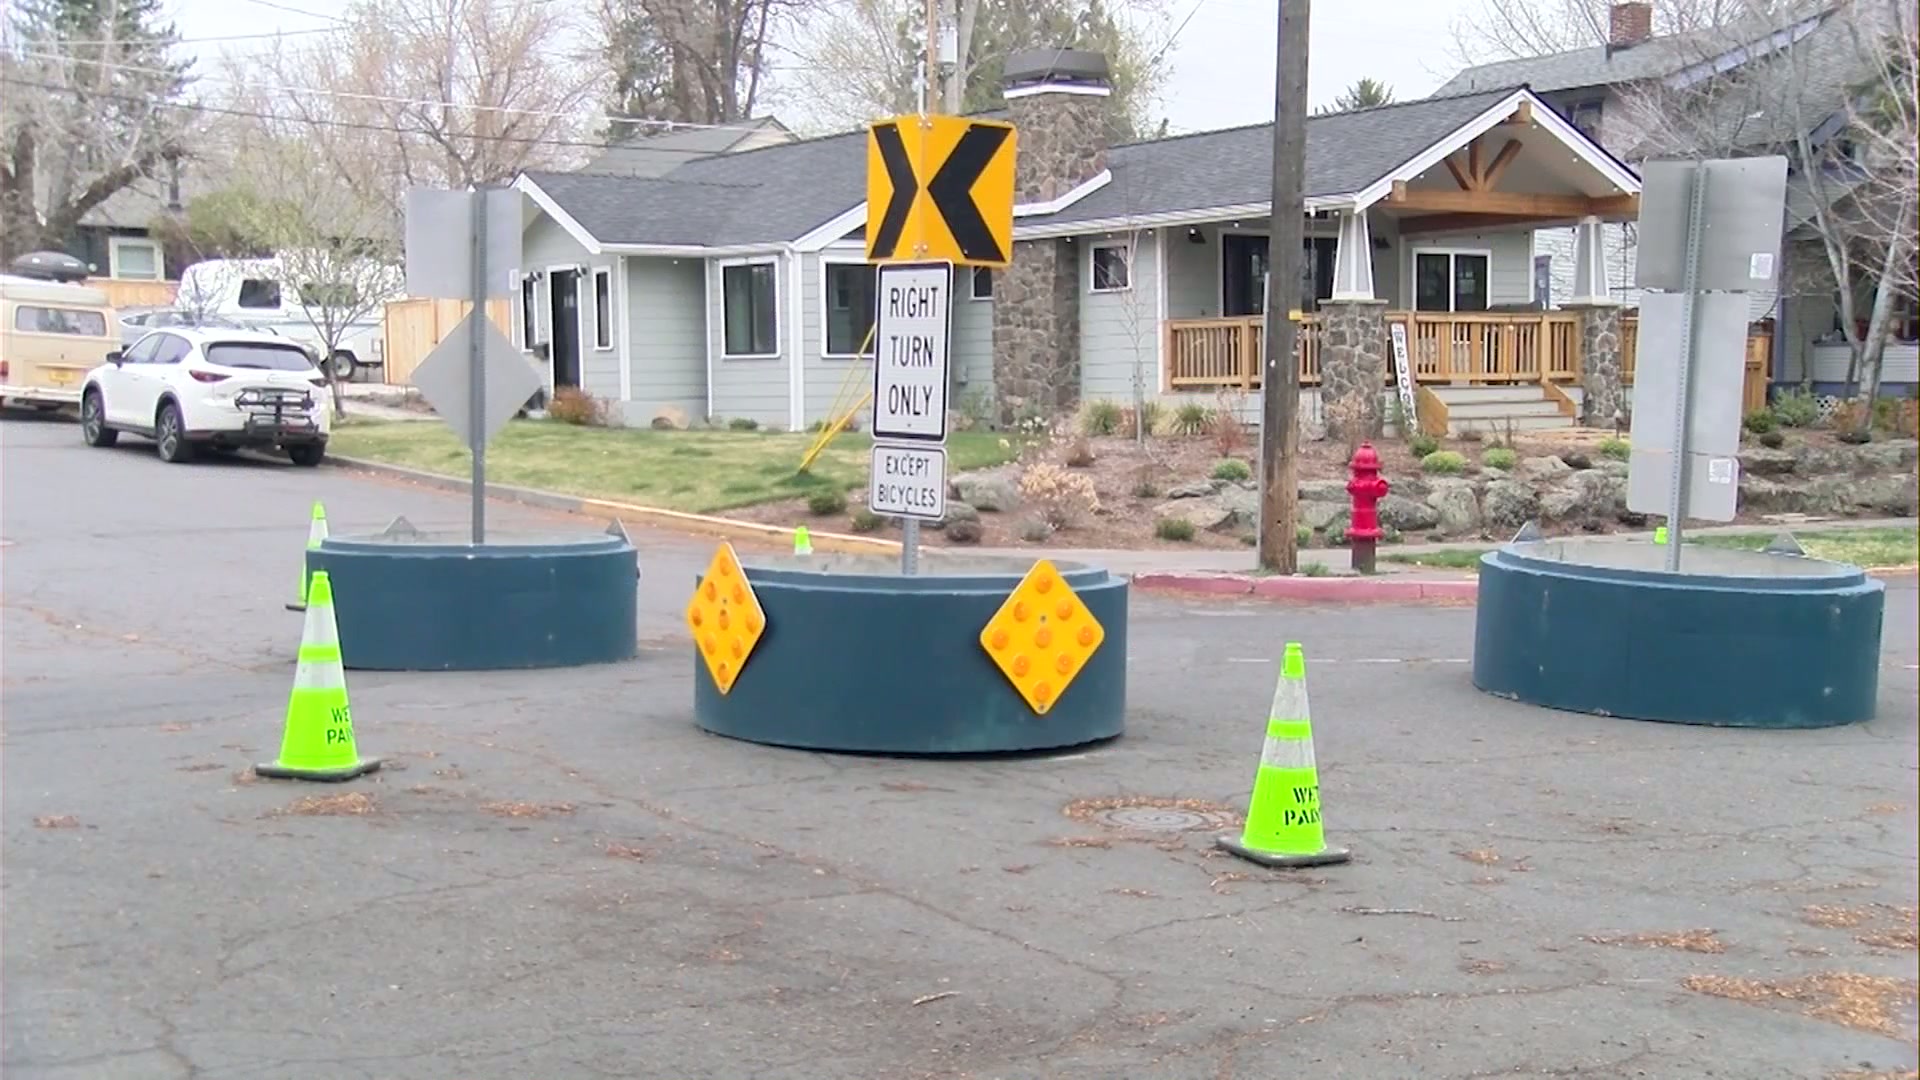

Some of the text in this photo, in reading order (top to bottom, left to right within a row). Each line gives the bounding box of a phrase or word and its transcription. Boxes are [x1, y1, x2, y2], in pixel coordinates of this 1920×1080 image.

[889, 286, 939, 318] RIGHT
[890, 335, 935, 368] TURN
[888, 384, 934, 416] ONLY
[885, 455, 930, 477] EXCEPT
[878, 484, 937, 508] BICYCLES
